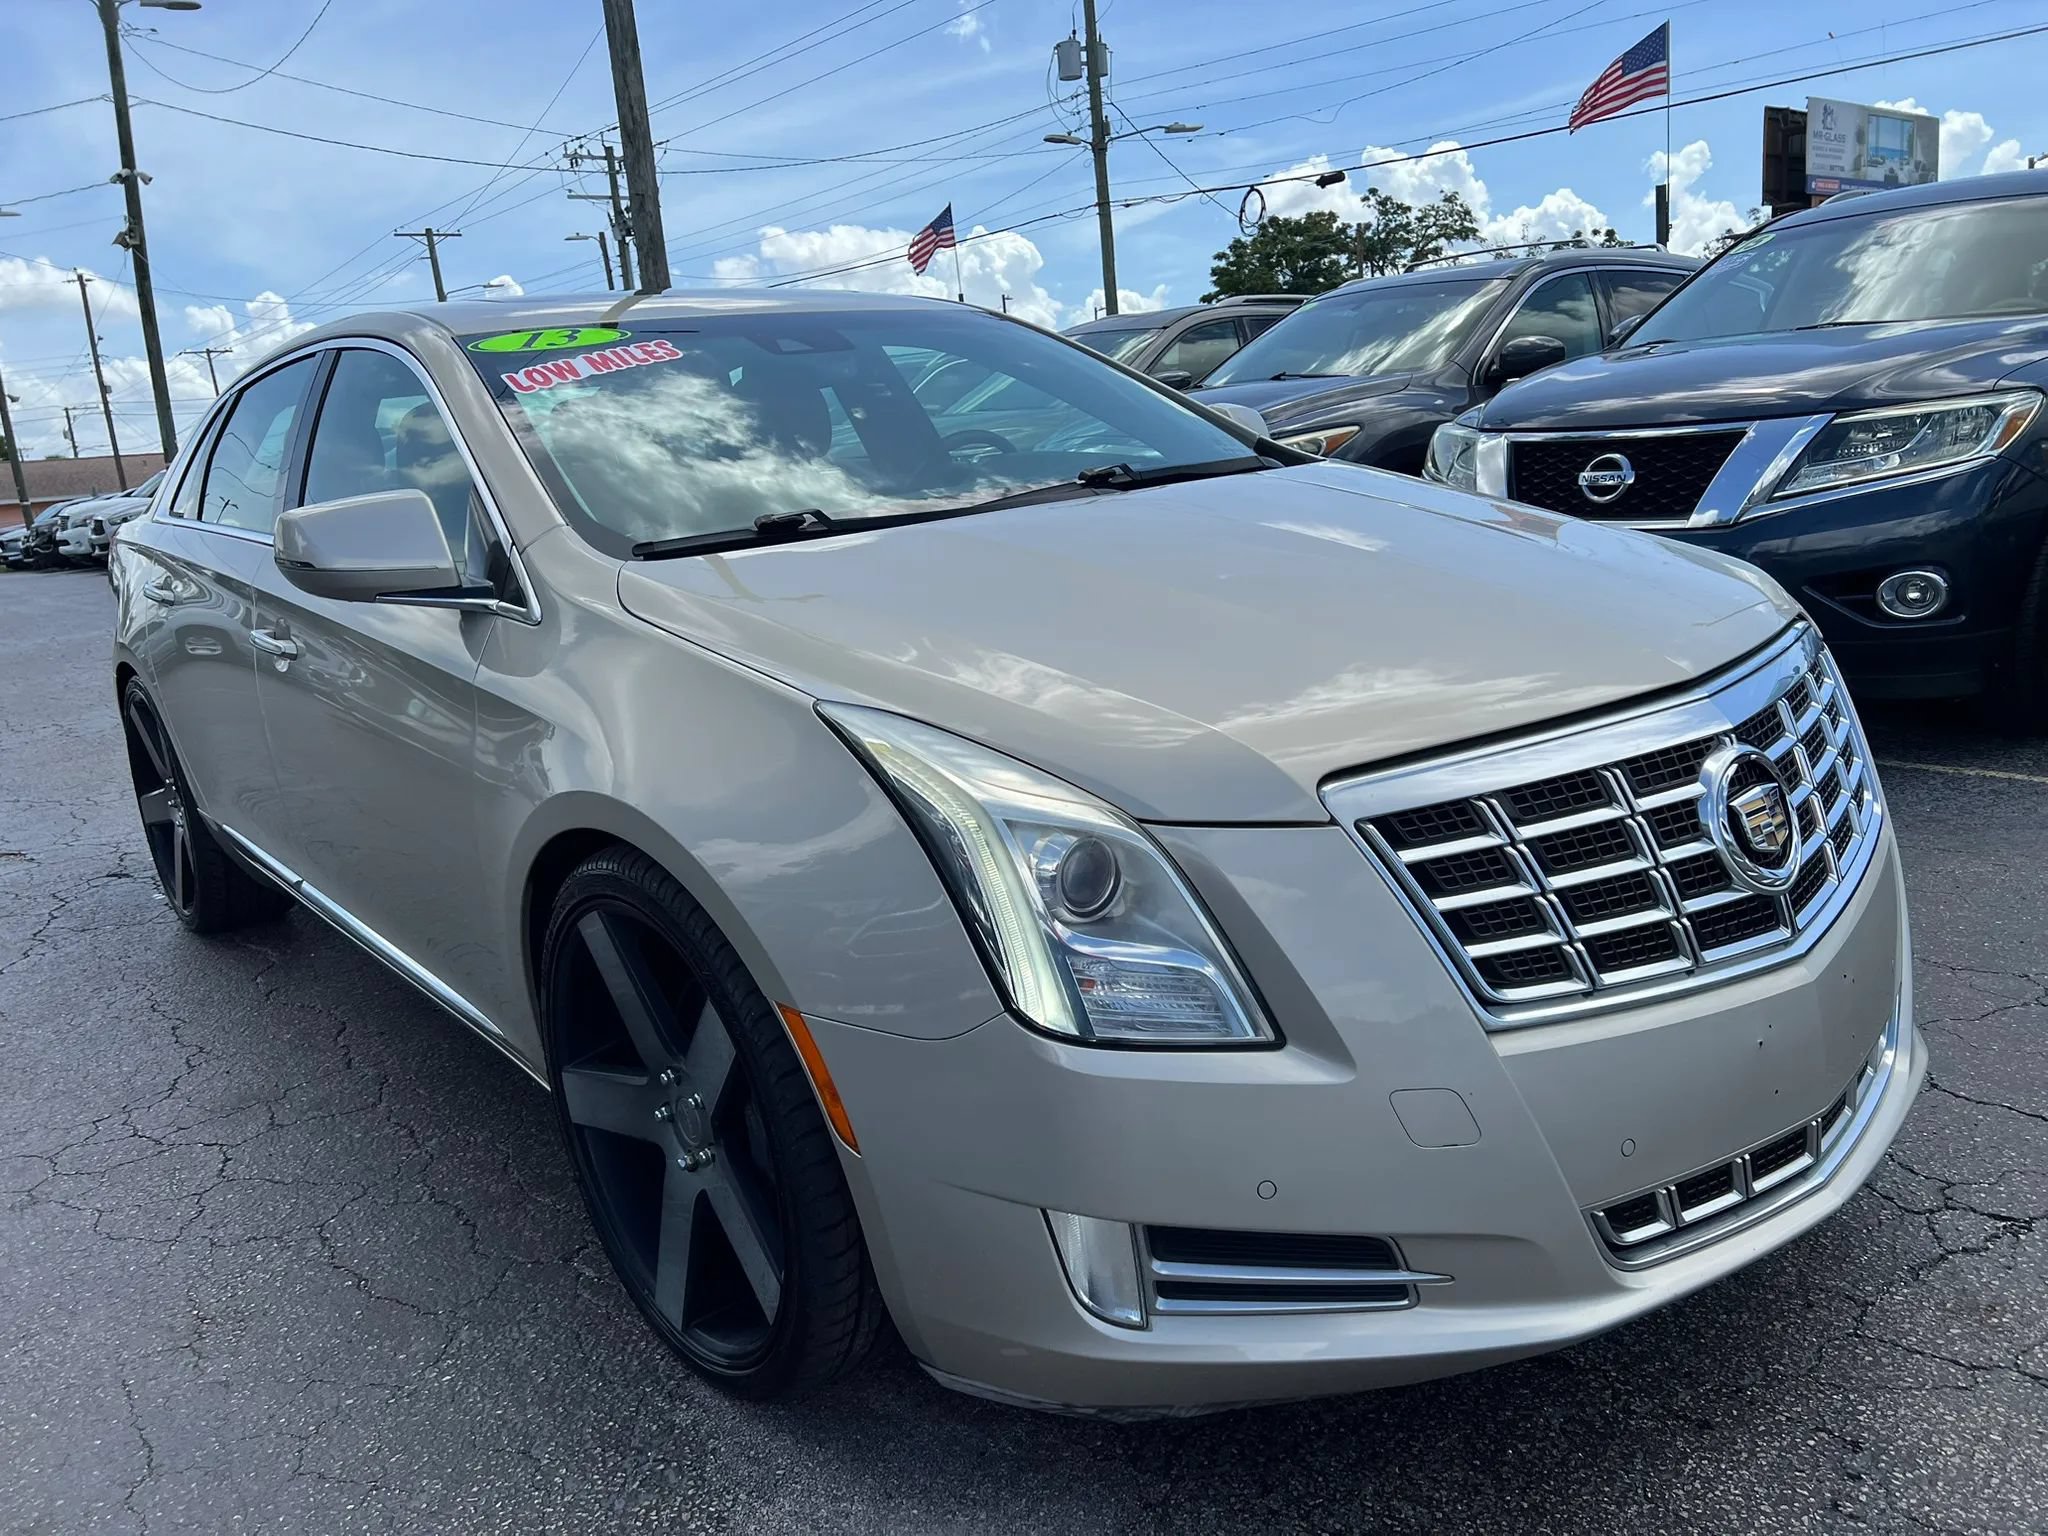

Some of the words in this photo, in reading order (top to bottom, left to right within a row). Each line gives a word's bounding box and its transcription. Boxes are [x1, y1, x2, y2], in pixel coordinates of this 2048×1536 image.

[521, 329, 580, 350] 13
[504, 359, 582, 393] LOW
[581, 340, 681, 373] MILES
[1581, 474, 1626, 483] NISSAN
